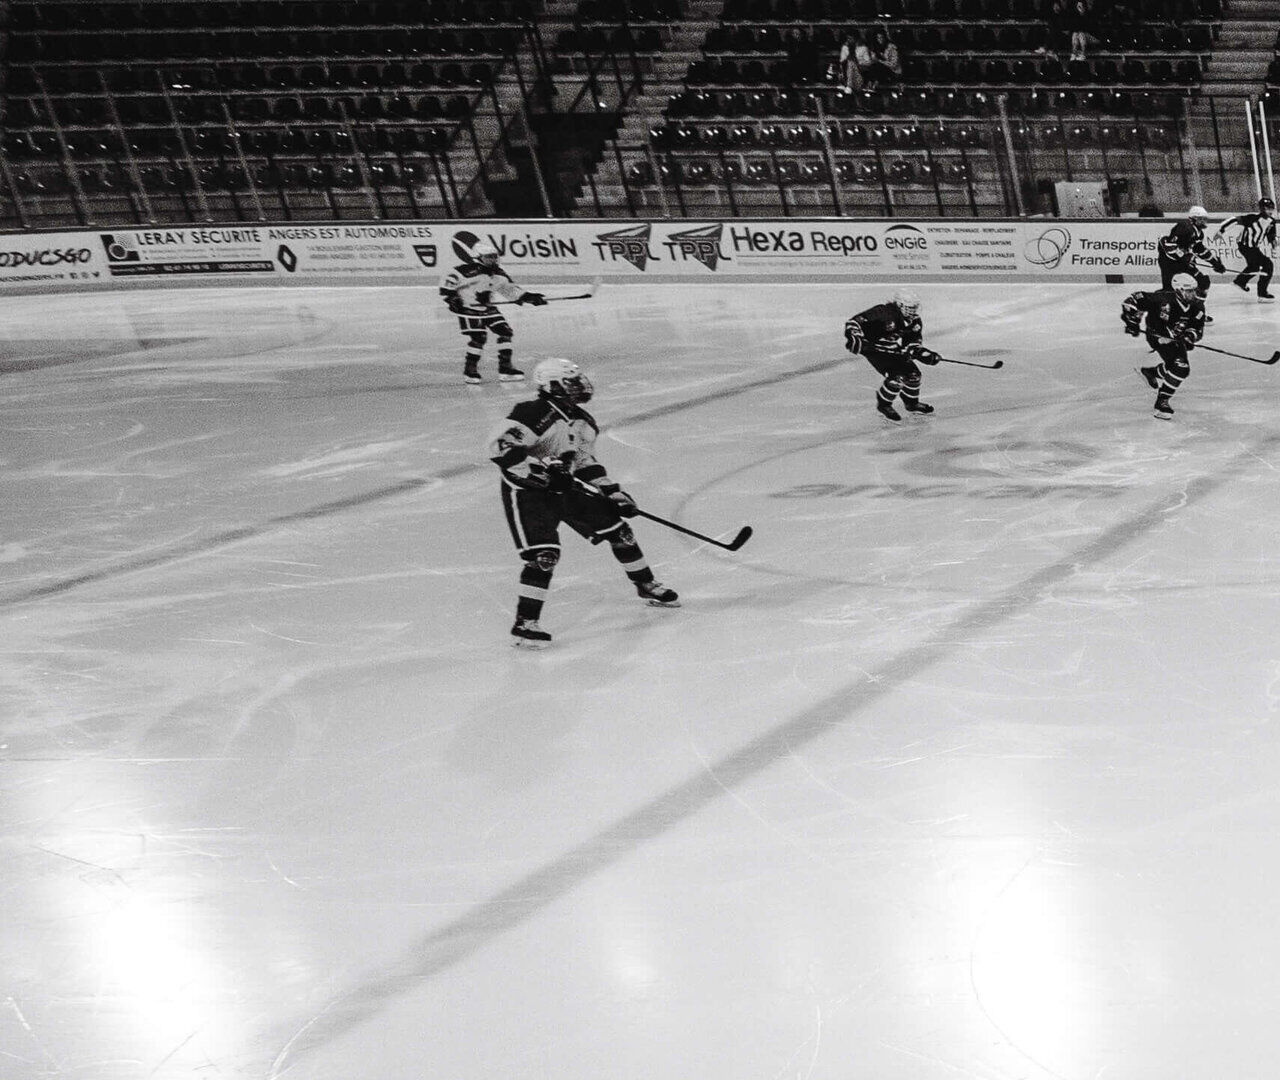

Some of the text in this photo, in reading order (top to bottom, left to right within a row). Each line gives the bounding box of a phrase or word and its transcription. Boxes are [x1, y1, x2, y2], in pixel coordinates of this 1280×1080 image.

[136, 231, 185, 246] LERAY
[268, 224, 433, 240] ANGERS EST AUTOMOBILES
[487, 232, 579, 259] Voisin
[731, 226, 879, 257] Hexa Repro
[1080, 239, 1157, 253] Transports
[1072, 254, 1160, 266] France Allian
